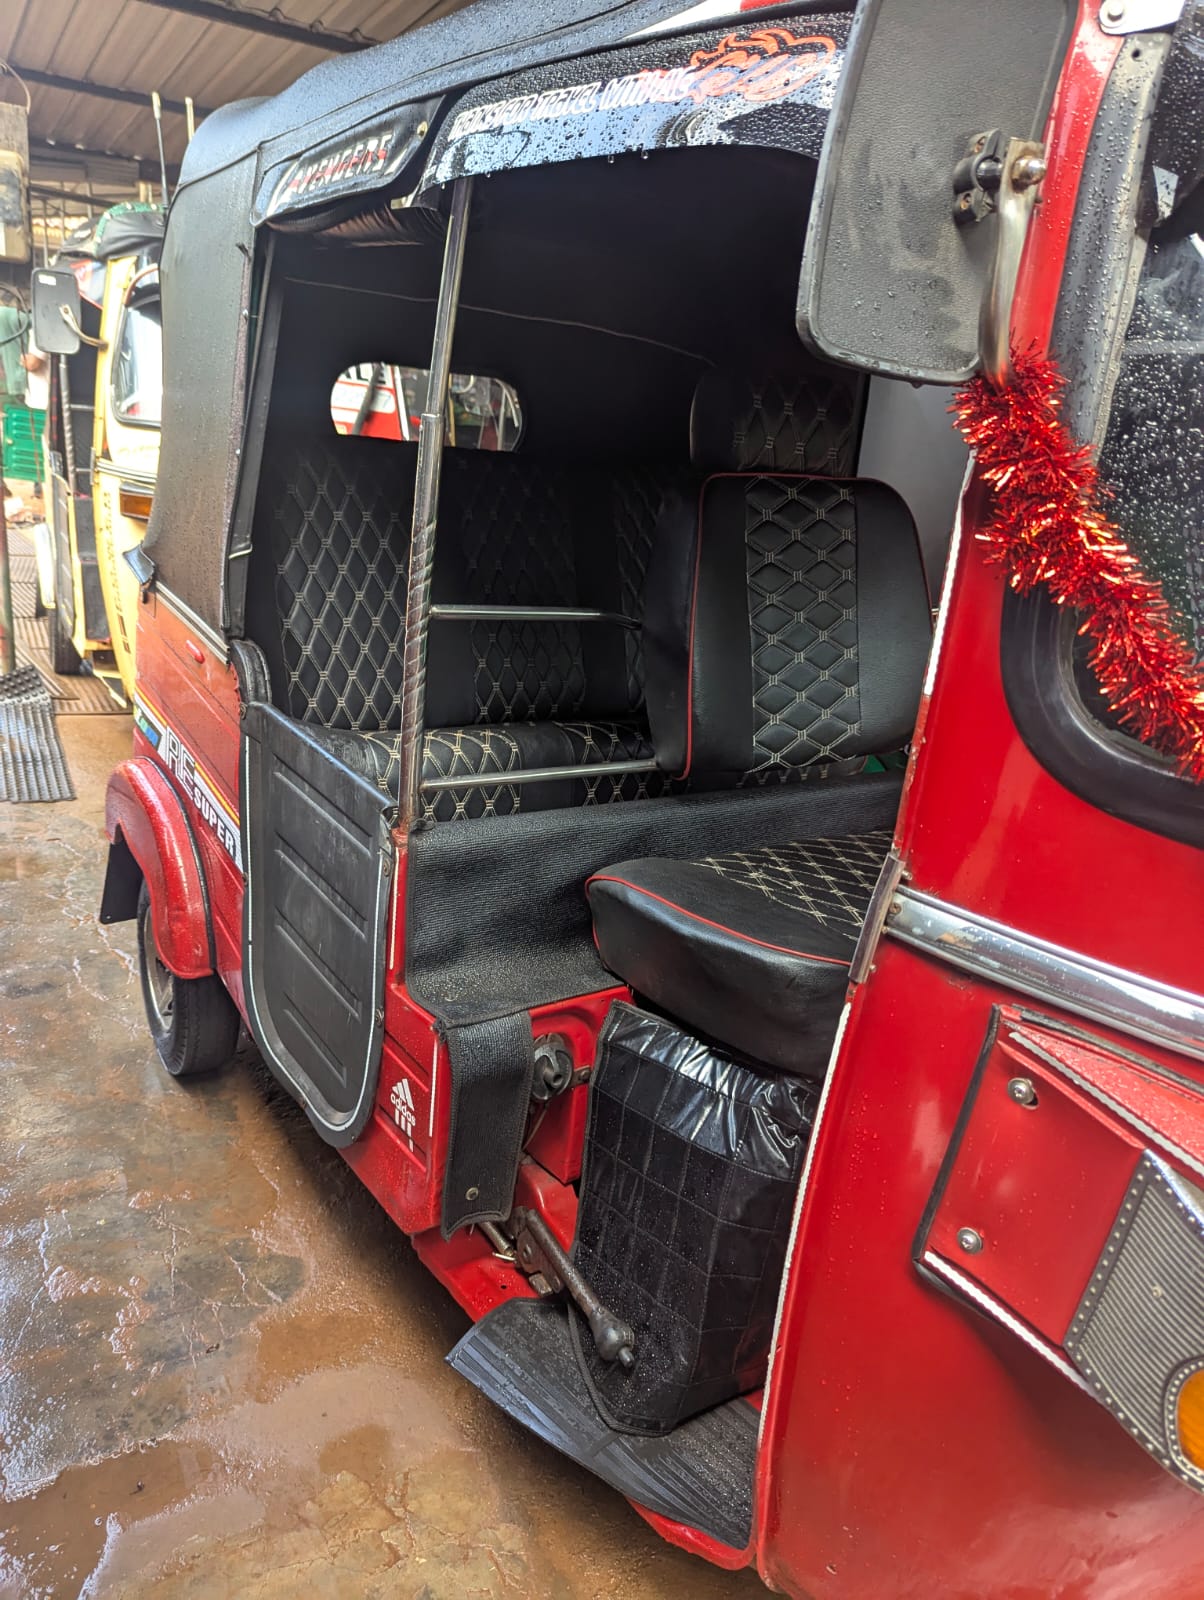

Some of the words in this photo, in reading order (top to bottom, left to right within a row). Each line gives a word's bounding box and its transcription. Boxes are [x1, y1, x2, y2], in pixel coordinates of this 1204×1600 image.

[166, 725, 196, 801] RE
[193, 785, 237, 860] SUPER
[390, 1093, 416, 1127] adidas
